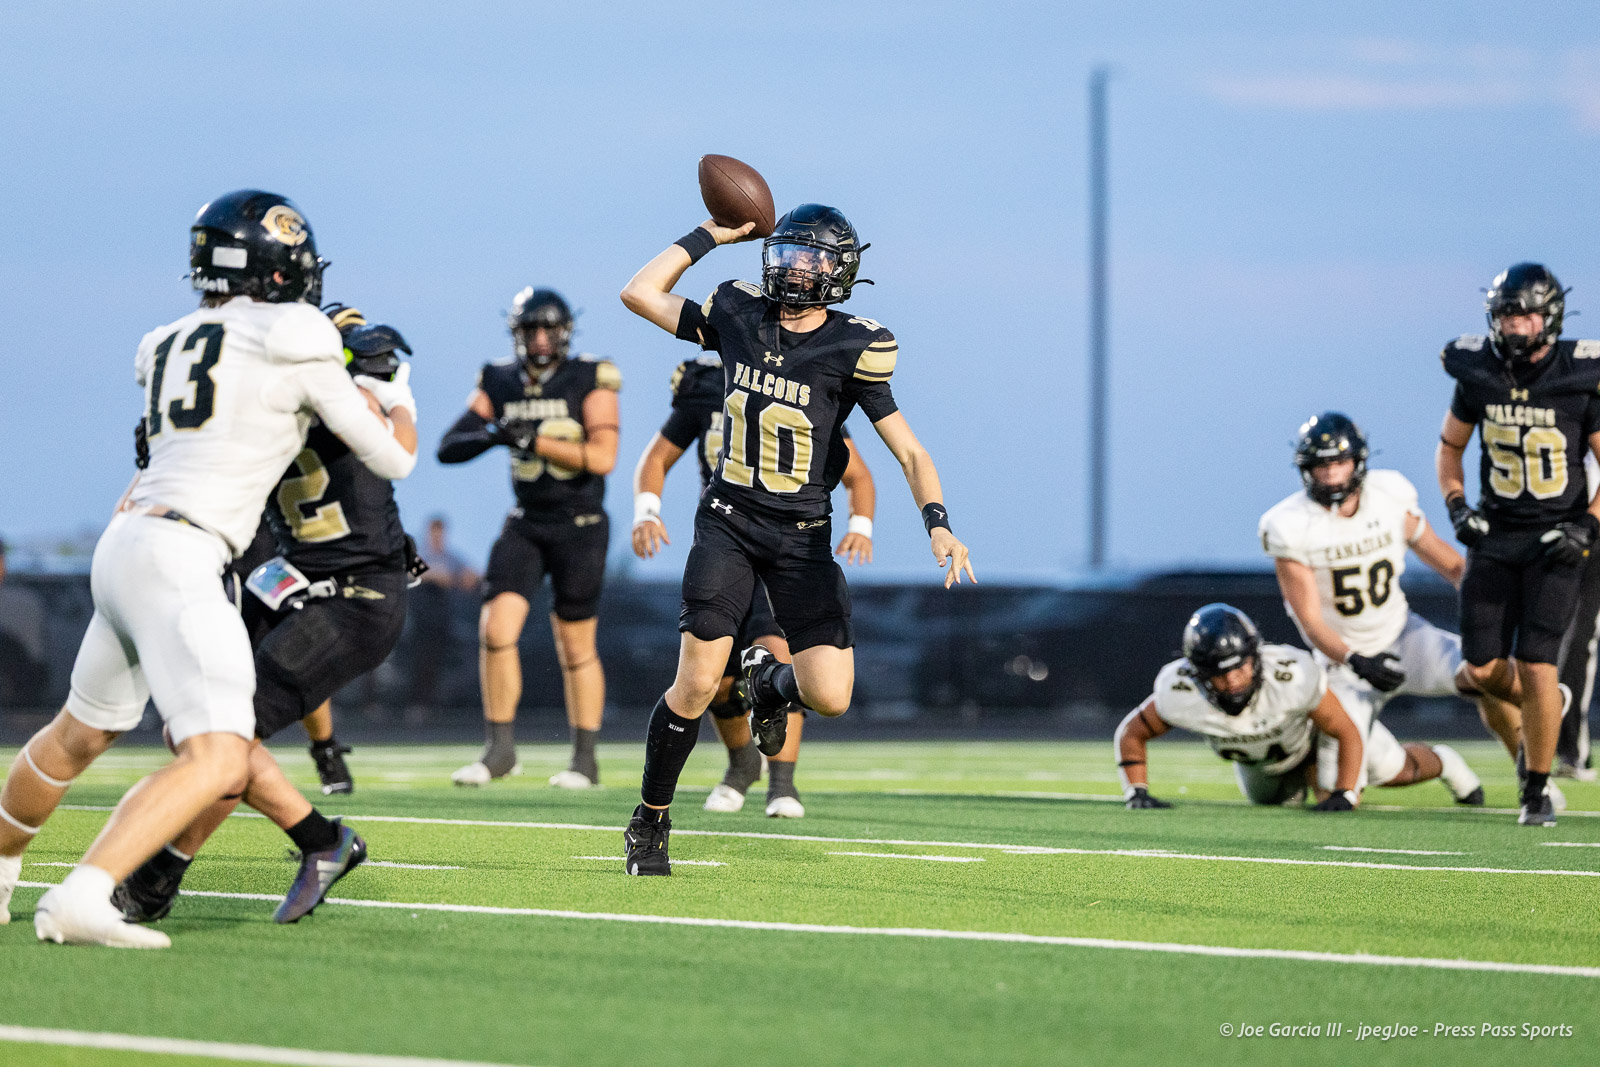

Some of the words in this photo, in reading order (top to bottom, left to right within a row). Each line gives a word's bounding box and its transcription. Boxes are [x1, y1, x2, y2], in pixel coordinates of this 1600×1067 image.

[147, 321, 226, 438] 13
[732, 361, 812, 407] FALCONS
[721, 387, 814, 494] 10
[1485, 403, 1556, 428] FALCONS
[1482, 418, 1569, 501] 50
[1331, 557, 1395, 617] 50
